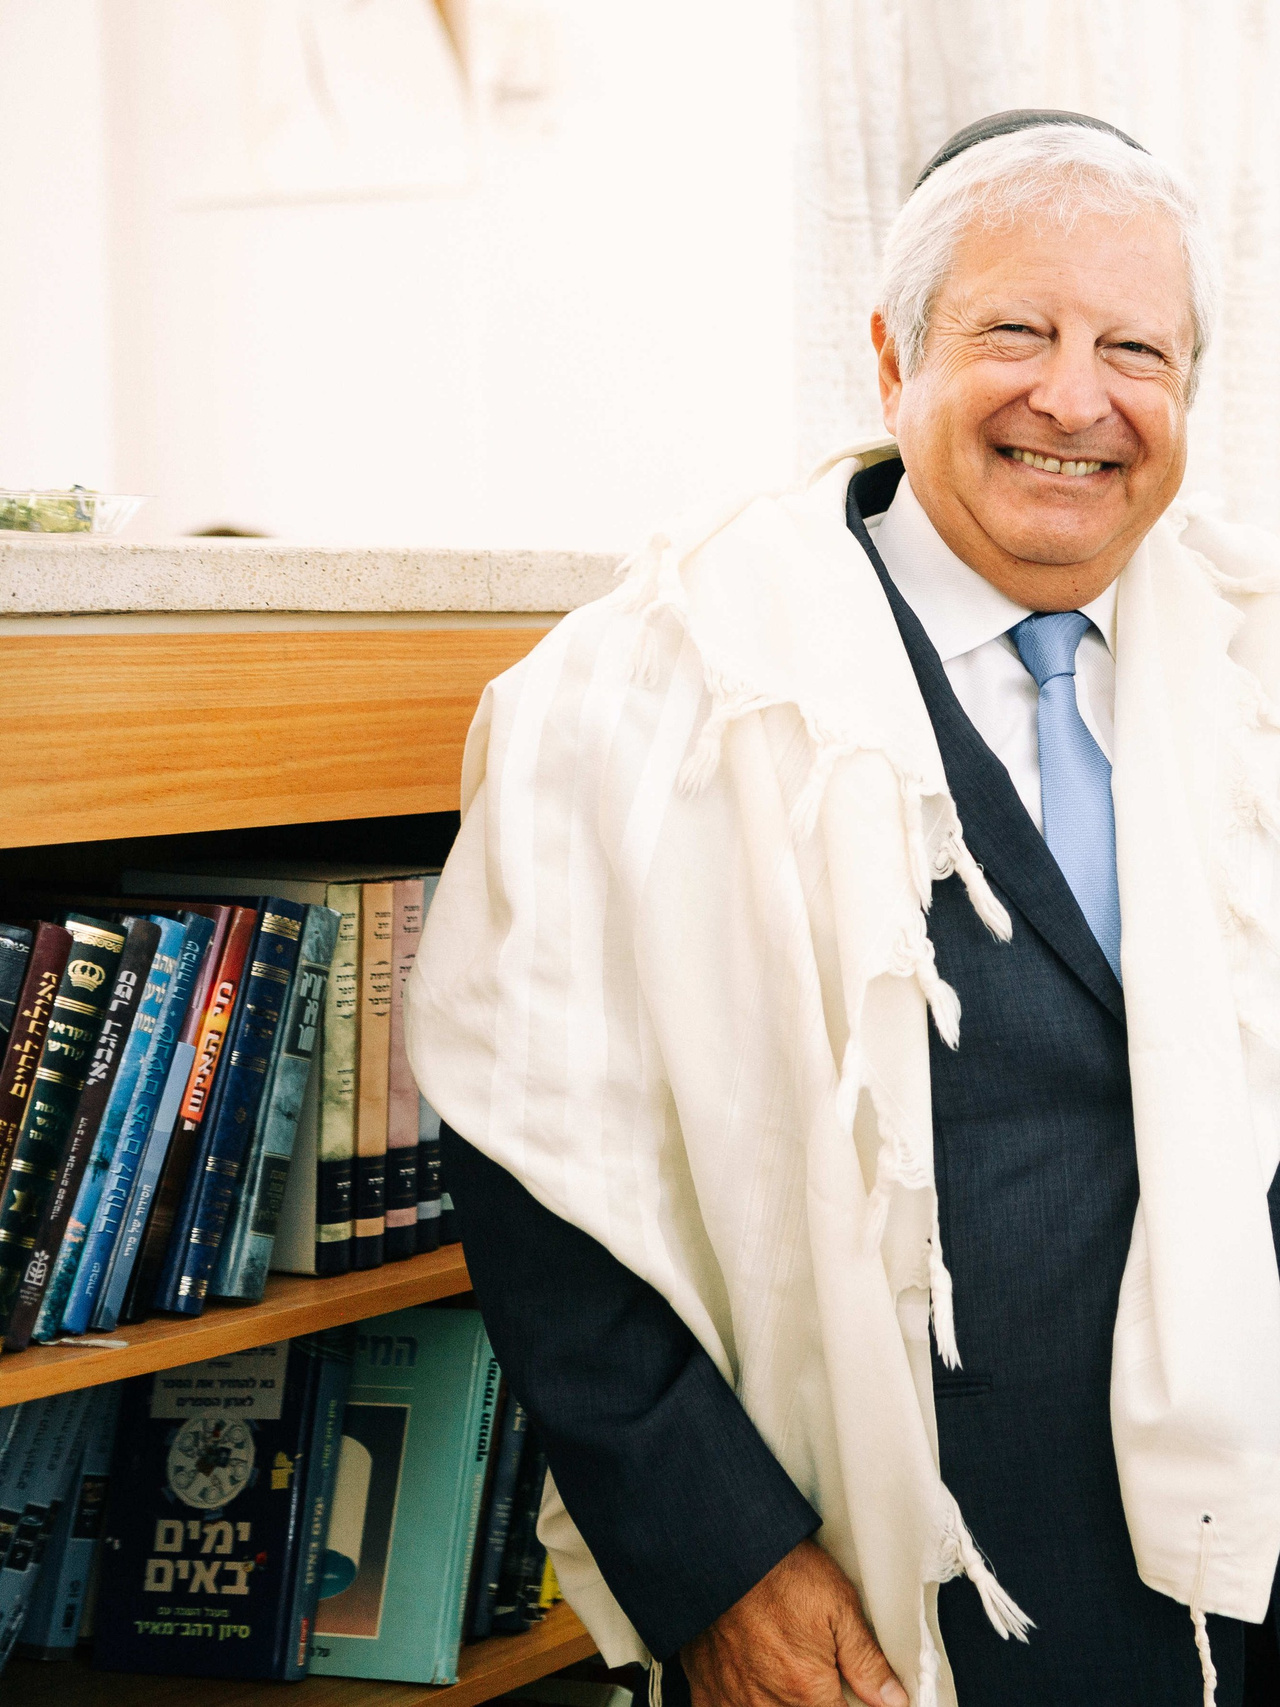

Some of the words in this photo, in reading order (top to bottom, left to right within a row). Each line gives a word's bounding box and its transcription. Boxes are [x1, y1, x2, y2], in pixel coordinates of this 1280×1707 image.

[151, 953, 178, 975] אהב
[178, 941, 200, 982] שמחה
[22, 971, 58, 1036] גאולה
[109, 970, 138, 1012] ספר
[142, 981, 167, 1004] לרע
[172, 984, 187, 1000] רז
[211, 977, 234, 1017] מי
[132, 1012, 156, 1034] כמו
[9, 1039, 39, 1098] לחיים
[86, 1019, 123, 1086] הגבאי
[141, 1023, 176, 1096] שבעים
[187, 1030, 222, 1113] האיש
[77, 1117, 89, 1136] הרב
[123, 1103, 150, 1155] פנים
[61, 1155, 77, 1187] אברהם
[98, 1162, 134, 1234] לתורה
[135, 1184, 152, 1215] הסידור
[127, 1218, 142, 1235] של
[124, 1236, 138, 1257] מירי
[86, 1262, 101, 1296] שמות
[355, 1334, 418, 1367] המי
[153, 1518, 252, 1555] ימים
[143, 1557, 251, 1596] באים
[217, 1624, 252, 1643] סיון
